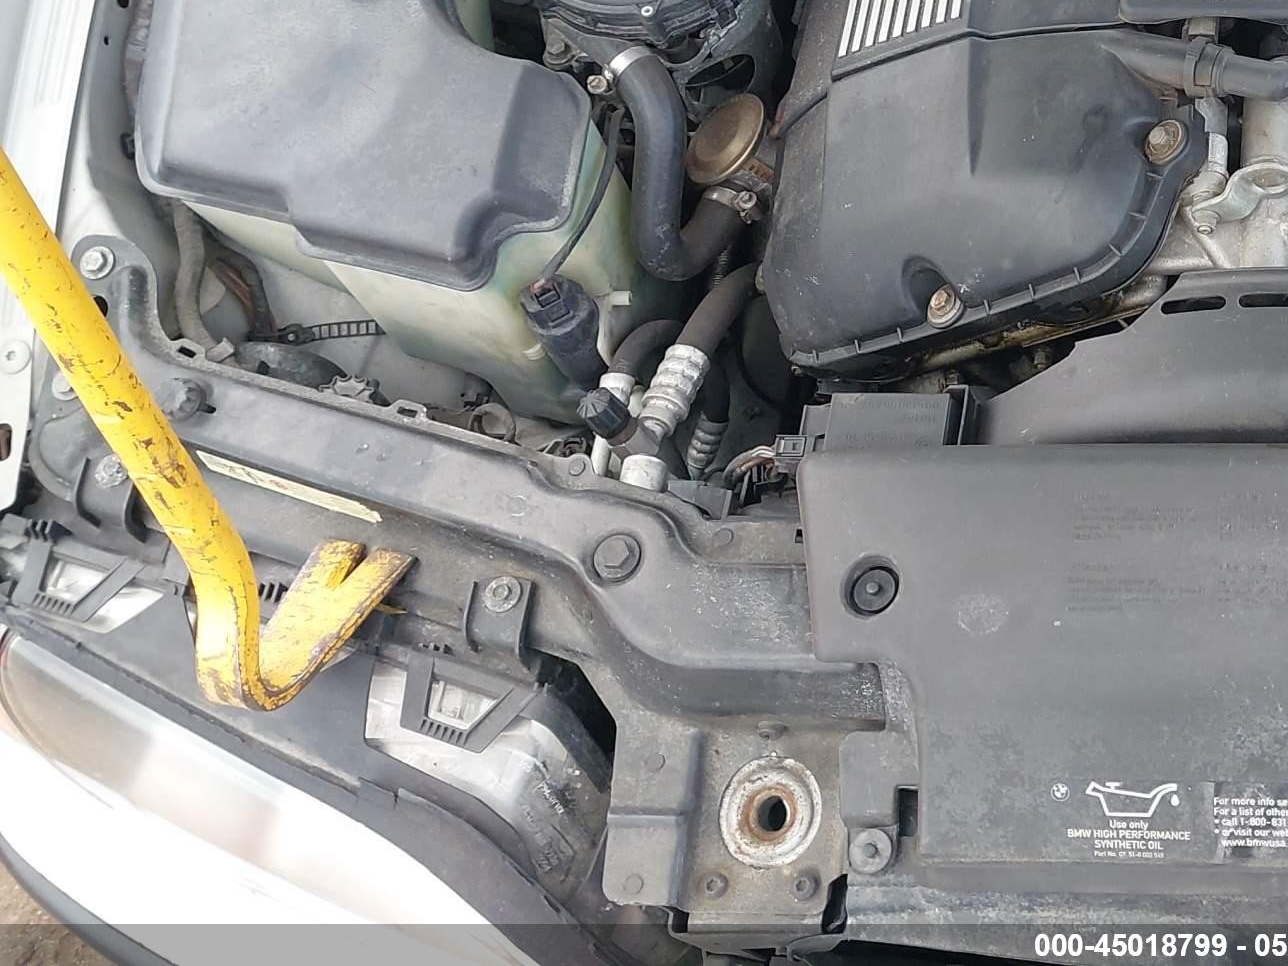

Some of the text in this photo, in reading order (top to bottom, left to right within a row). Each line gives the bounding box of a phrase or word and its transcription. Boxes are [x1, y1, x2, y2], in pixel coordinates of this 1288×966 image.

[1213, 797, 1229, 806] For
[1231, 798, 1255, 807] more
[1257, 797, 1275, 807] info
[1213, 807, 1228, 816] For
[1239, 807, 1254, 817] list
[1255, 807, 1265, 817] of
[1109, 819, 1149, 831] Use only
[1221, 818, 1238, 827] call
[1067, 828, 1191, 841] BMW HIGH PERFORMANCE
[1221, 829, 1231, 837] or
[1232, 828, 1253, 837] visit
[1254, 829, 1270, 837] our
[1094, 839, 1164, 850] SYNTHETIC OIL
